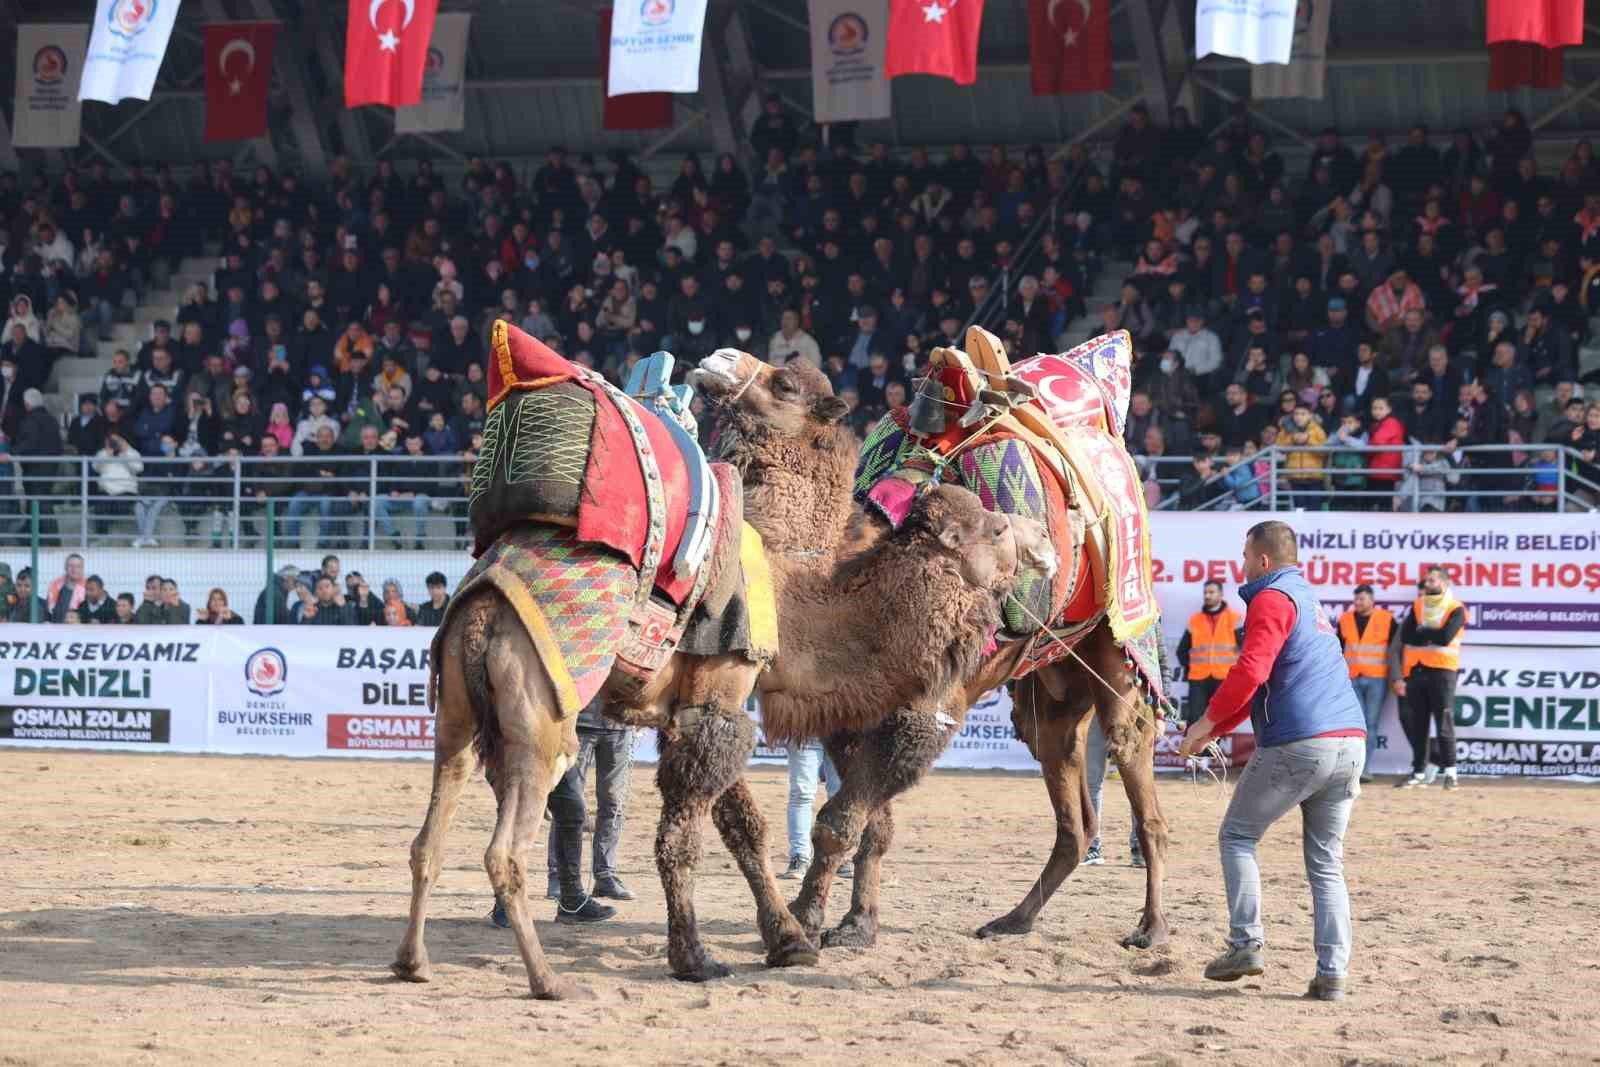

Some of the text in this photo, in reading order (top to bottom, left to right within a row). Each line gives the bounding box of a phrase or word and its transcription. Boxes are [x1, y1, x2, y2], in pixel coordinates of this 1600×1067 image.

[1297, 529, 1355, 549] NİZLİ
[1363, 529, 1508, 552] BÜYÜKŞEHİR
[1298, 556, 1520, 589] ÜREŞLRİNE
[1532, 562, 1600, 592] HOŞ
[1482, 608, 1548, 622] BÜYÜKŞEHİR
[65, 643, 200, 662] SEVDAMIZ
[1516, 669, 1600, 689] SEVD
[13, 708, 152, 728] OSMAN ZOLAN
[347, 718, 420, 736] OSMAN
[1456, 741, 1537, 761] OSMAN
